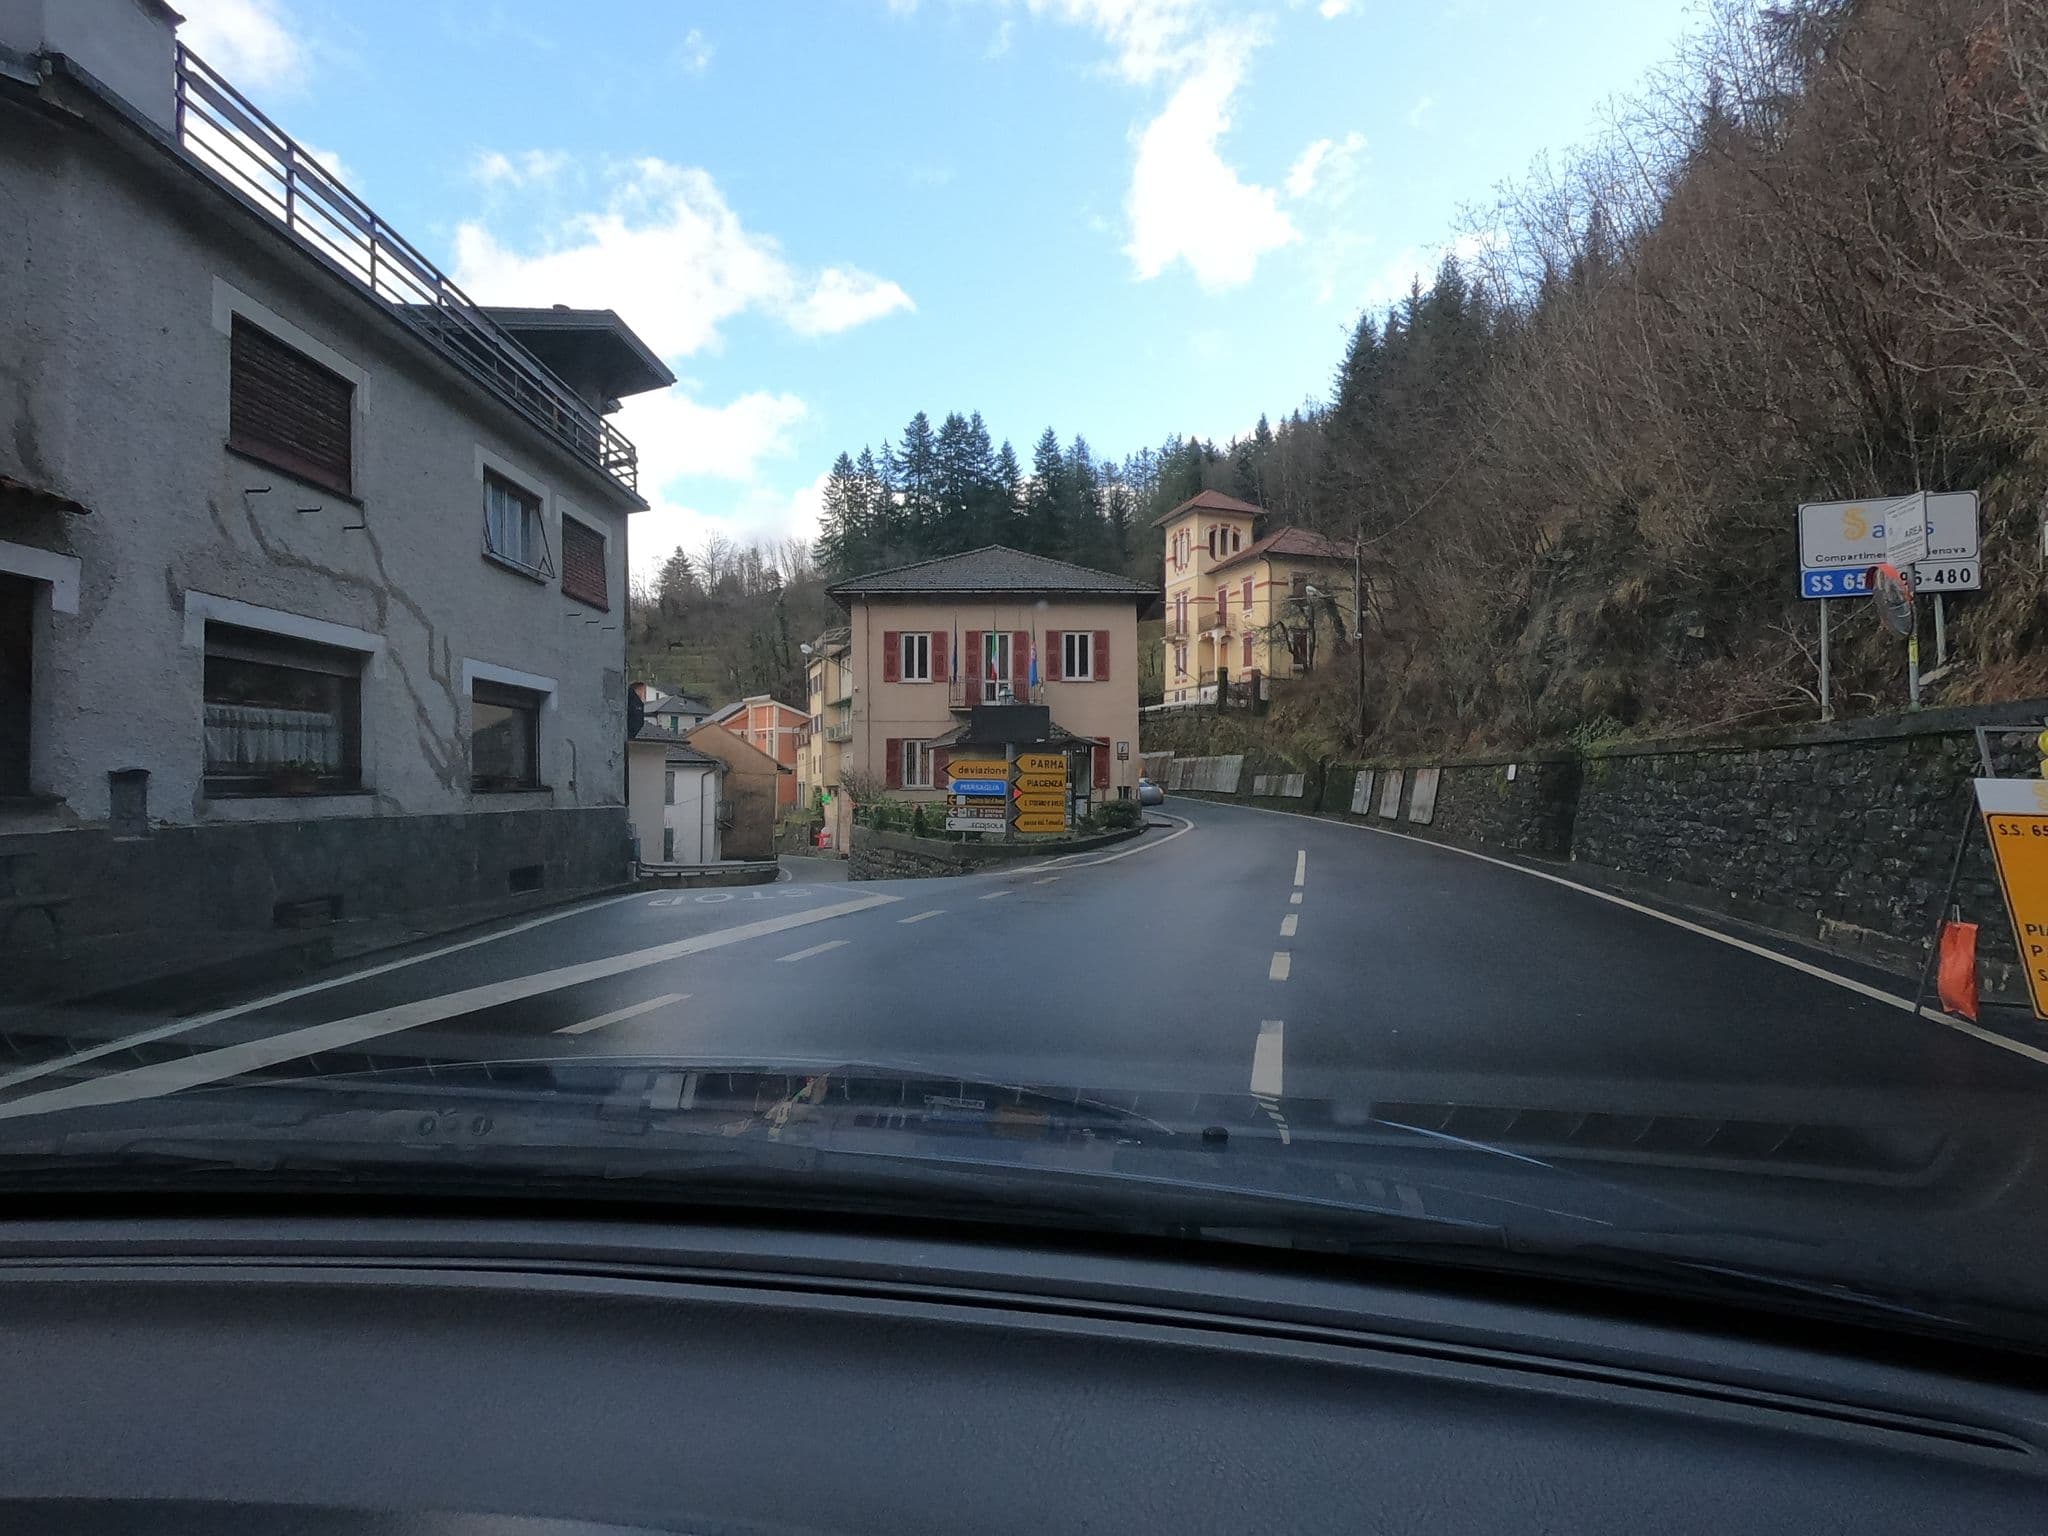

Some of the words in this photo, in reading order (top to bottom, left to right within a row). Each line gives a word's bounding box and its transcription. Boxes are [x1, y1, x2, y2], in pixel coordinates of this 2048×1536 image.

[1811, 575, 1833, 592] SS
[1030, 759, 1064, 768] PARMA
[958, 766, 1007, 775] deviazione
[1027, 780, 1063, 788] PIACENZA
